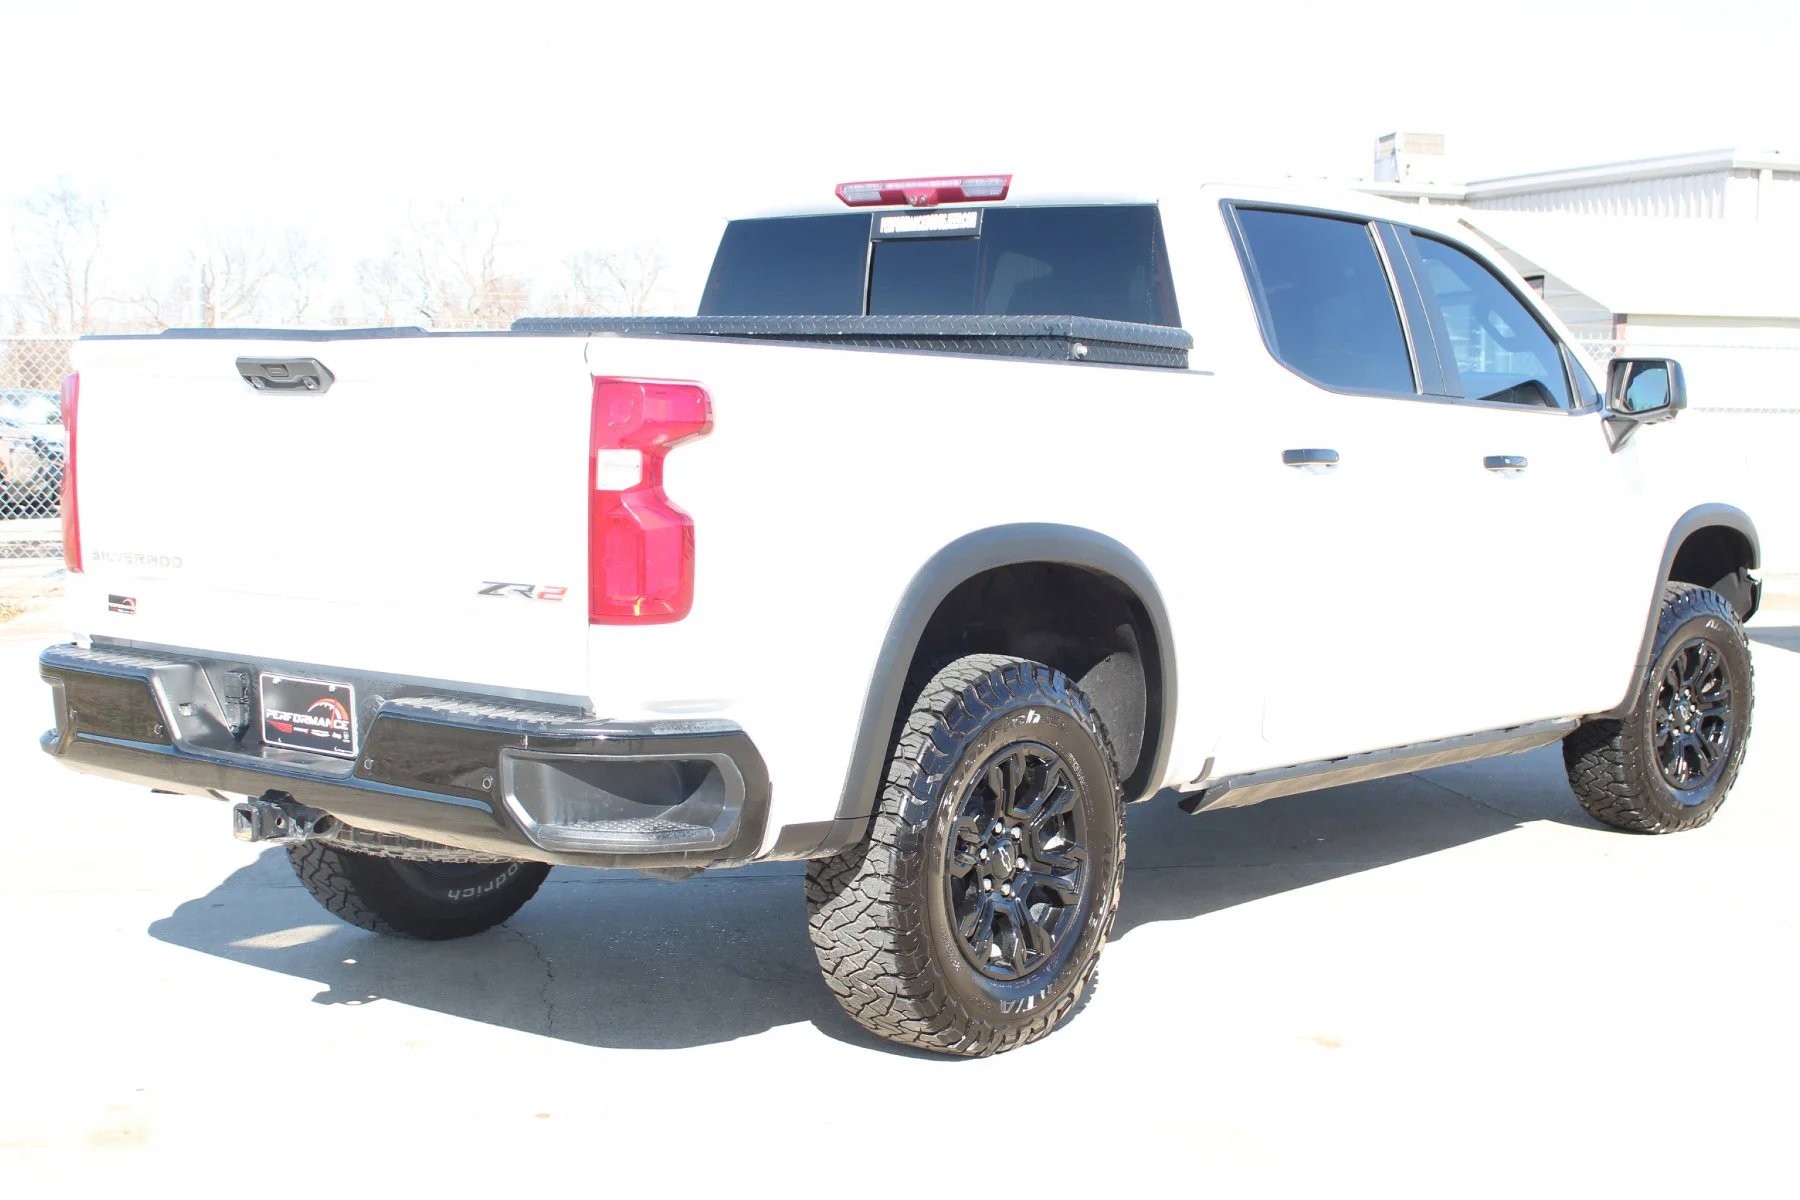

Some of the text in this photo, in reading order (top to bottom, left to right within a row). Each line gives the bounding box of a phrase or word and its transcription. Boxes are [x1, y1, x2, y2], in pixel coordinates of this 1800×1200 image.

[91, 548, 183, 569] SILVERADO
[477, 580, 569, 601] ZR2
[265, 708, 350, 730] PERFORMANCE
[447, 861, 520, 900] odrich
